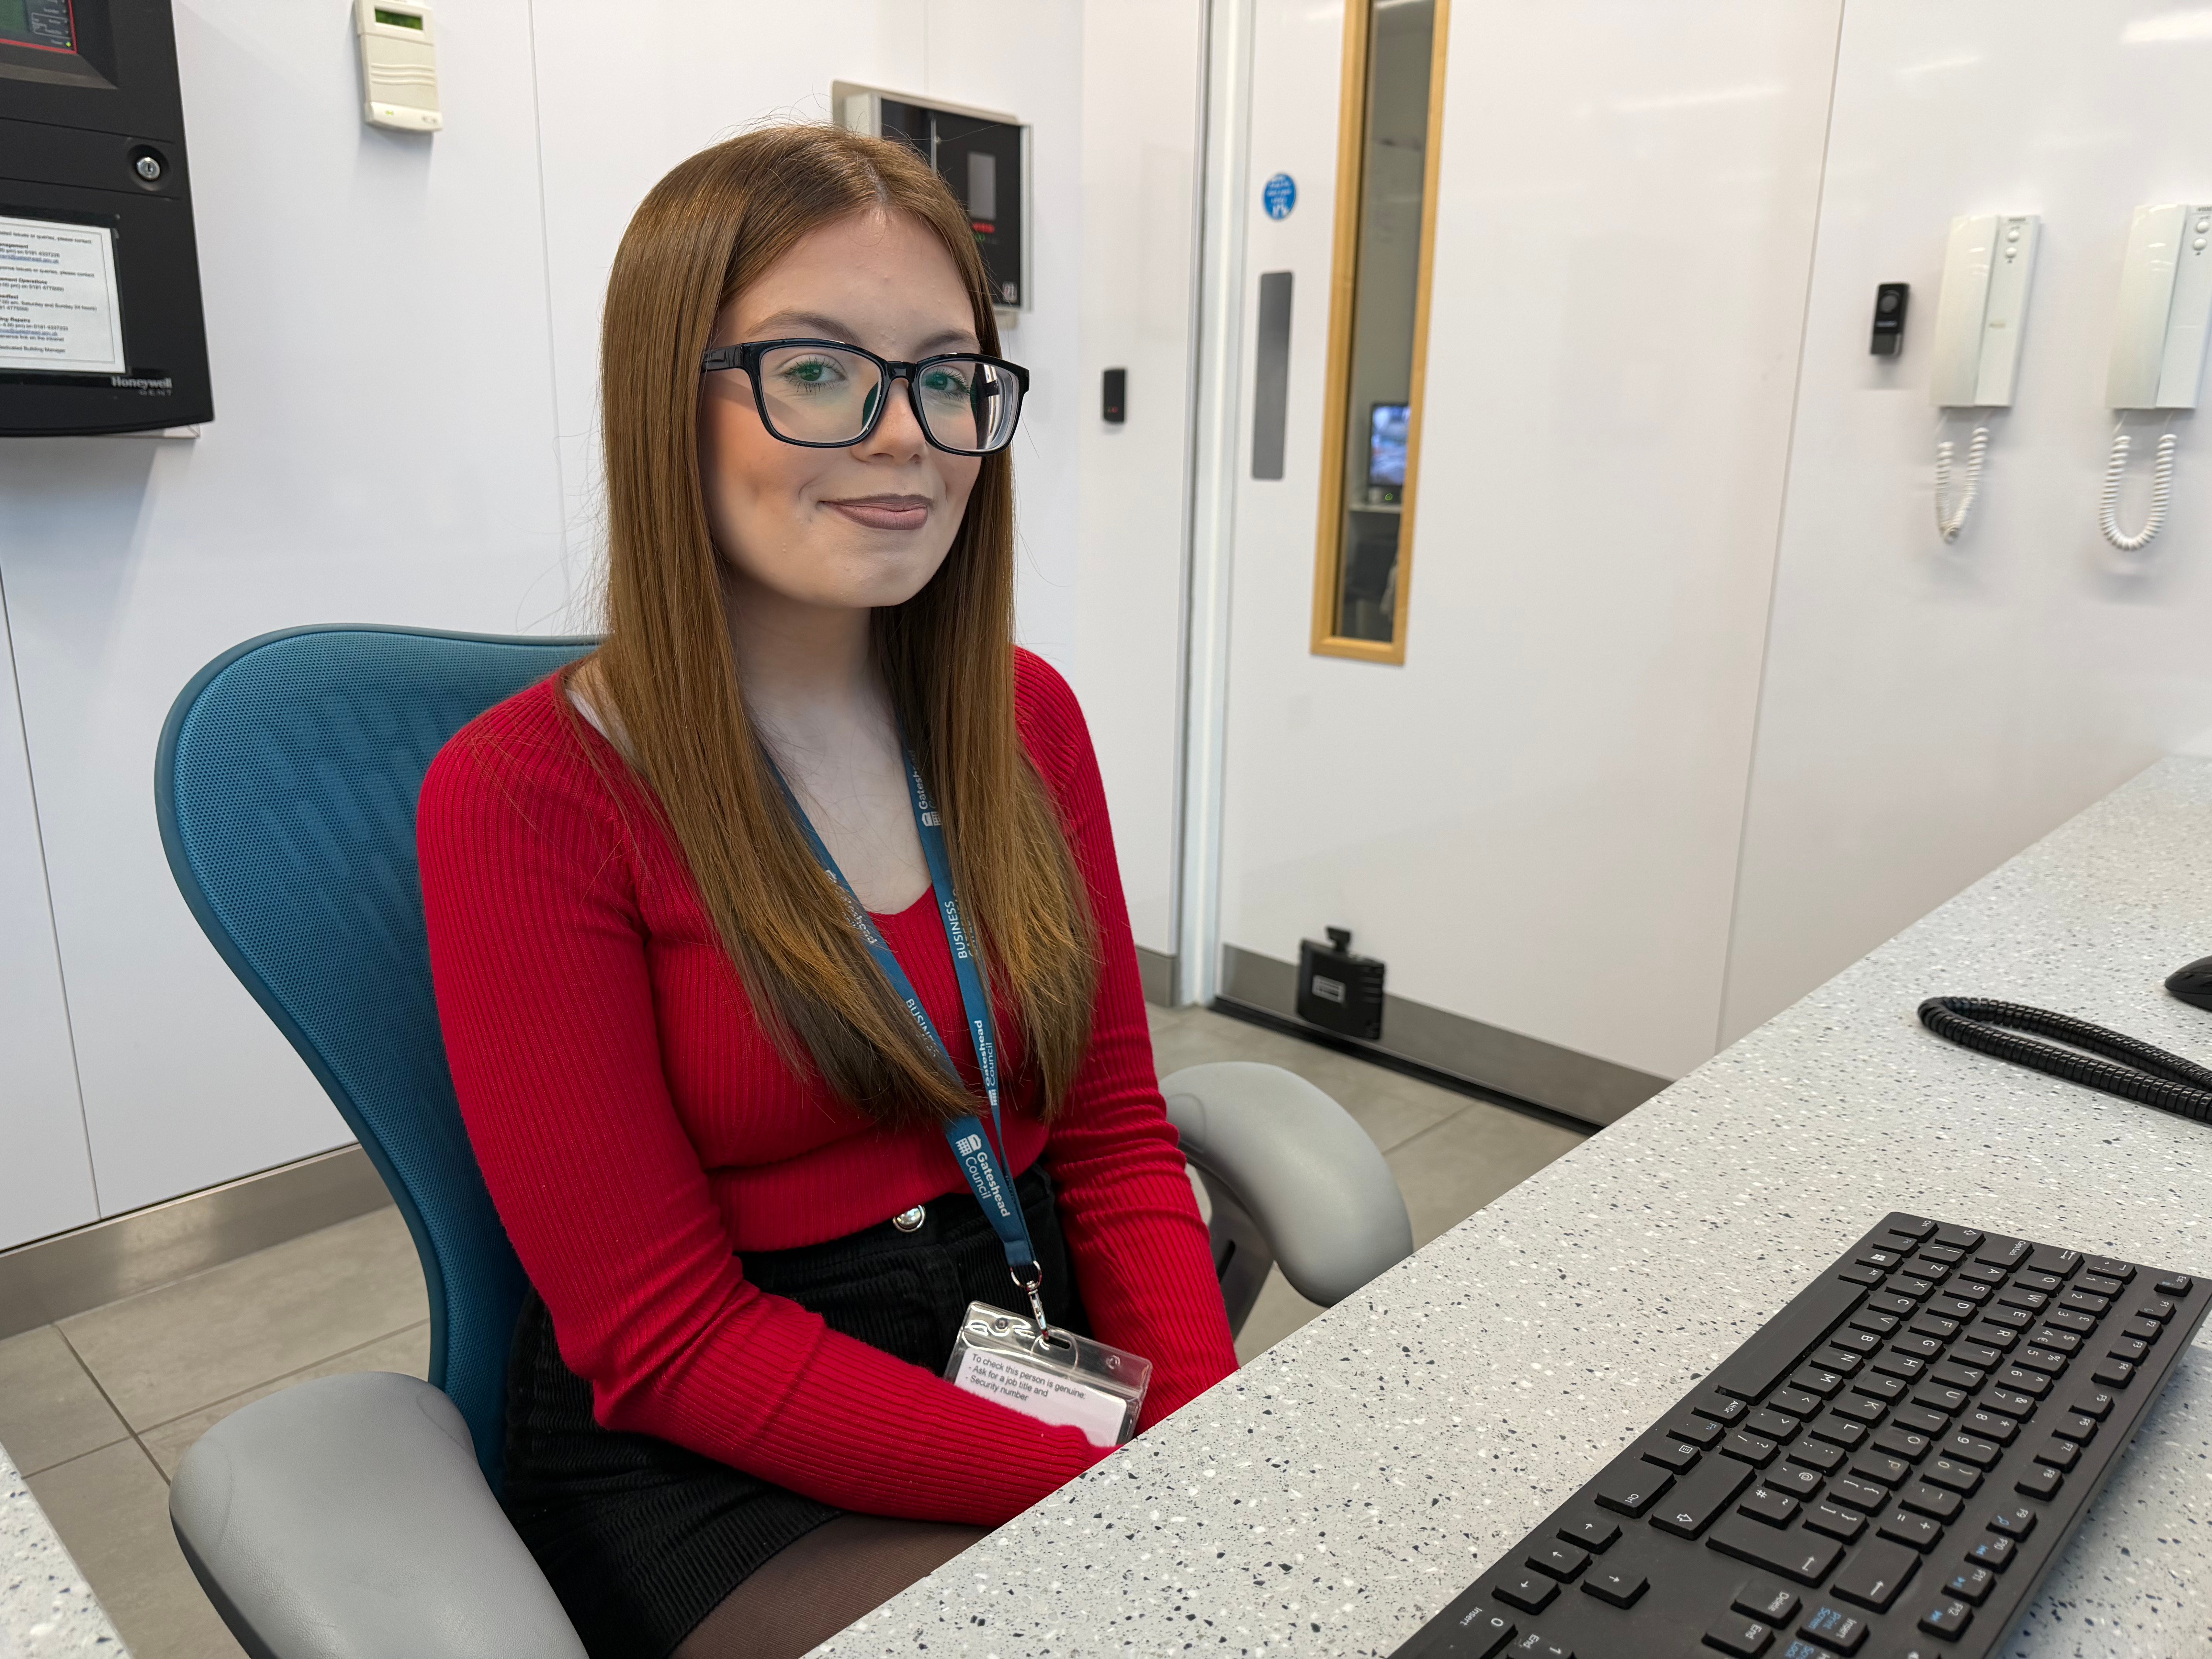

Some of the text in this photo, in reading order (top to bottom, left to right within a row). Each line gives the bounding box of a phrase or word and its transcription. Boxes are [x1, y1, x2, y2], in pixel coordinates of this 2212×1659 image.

[111, 376, 172, 390] Honeywell
[945, 901, 968, 958] BUSINESS
[974, 1020, 990, 1087] Gateshead
[986, 1042, 996, 1086] Council
[965, 1156, 992, 1199] Council
[977, 1152, 1011, 1217] Gateshead
[972, 1353, 982, 1362] To
[983, 1358, 1004, 1371] check
[1006, 1365, 1019, 1376] this
[1019, 1372, 1045, 1385] person
[1047, 1379, 1053, 1388] is
[1903, 1359, 1918, 1367] H
[970, 1375, 1029, 1401] Security number
[972, 1365, 987, 1376] Ask
[988, 1370, 998, 1379] for
[1005, 1376, 1018, 1386] job
[1019, 1380, 1032, 1391] title
[1034, 1387, 1049, 1398] and
[1820, 1374, 1835, 1382] M
[1864, 1401, 1879, 1409] K
[1625, 1494, 1639, 1503] Ctrl
[1767, 1591, 1790, 1611] Delete
[1460, 1607, 1483, 1626] Insert
[1745, 1623, 1762, 1640] End
[1836, 1618, 1857, 1638] Insert
